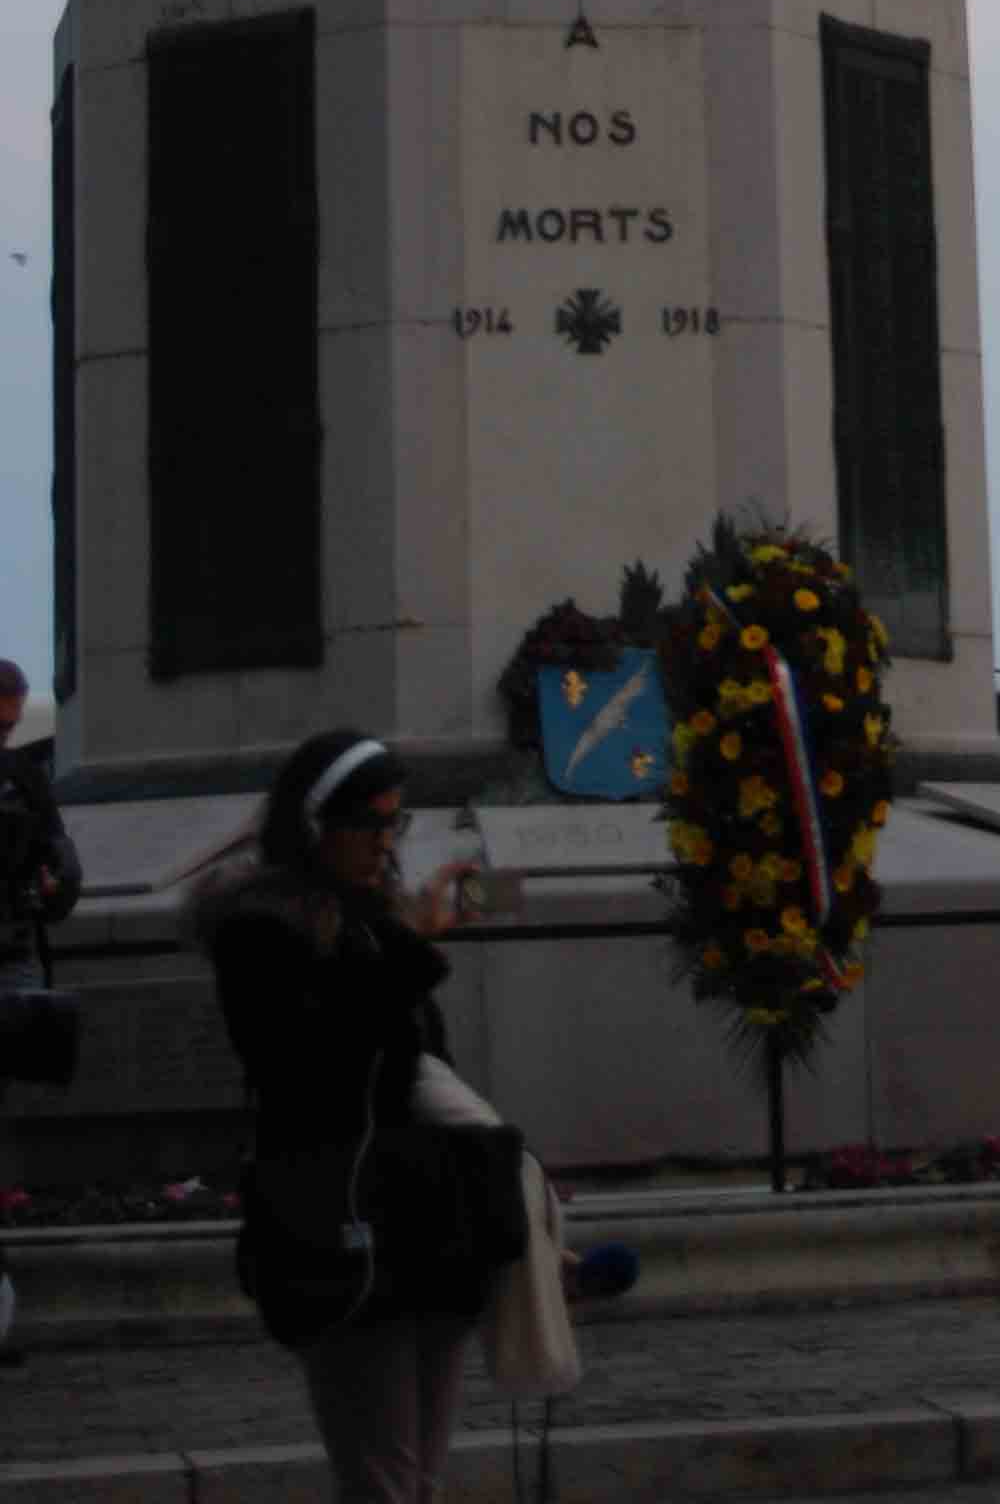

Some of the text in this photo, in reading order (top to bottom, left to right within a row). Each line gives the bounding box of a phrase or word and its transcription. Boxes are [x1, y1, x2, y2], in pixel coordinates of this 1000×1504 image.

[564, 15, 599, 50] A
[526, 108, 637, 149] NOS
[495, 206, 675, 246] MORTS
[451, 304, 722, 340] 1914 1918
